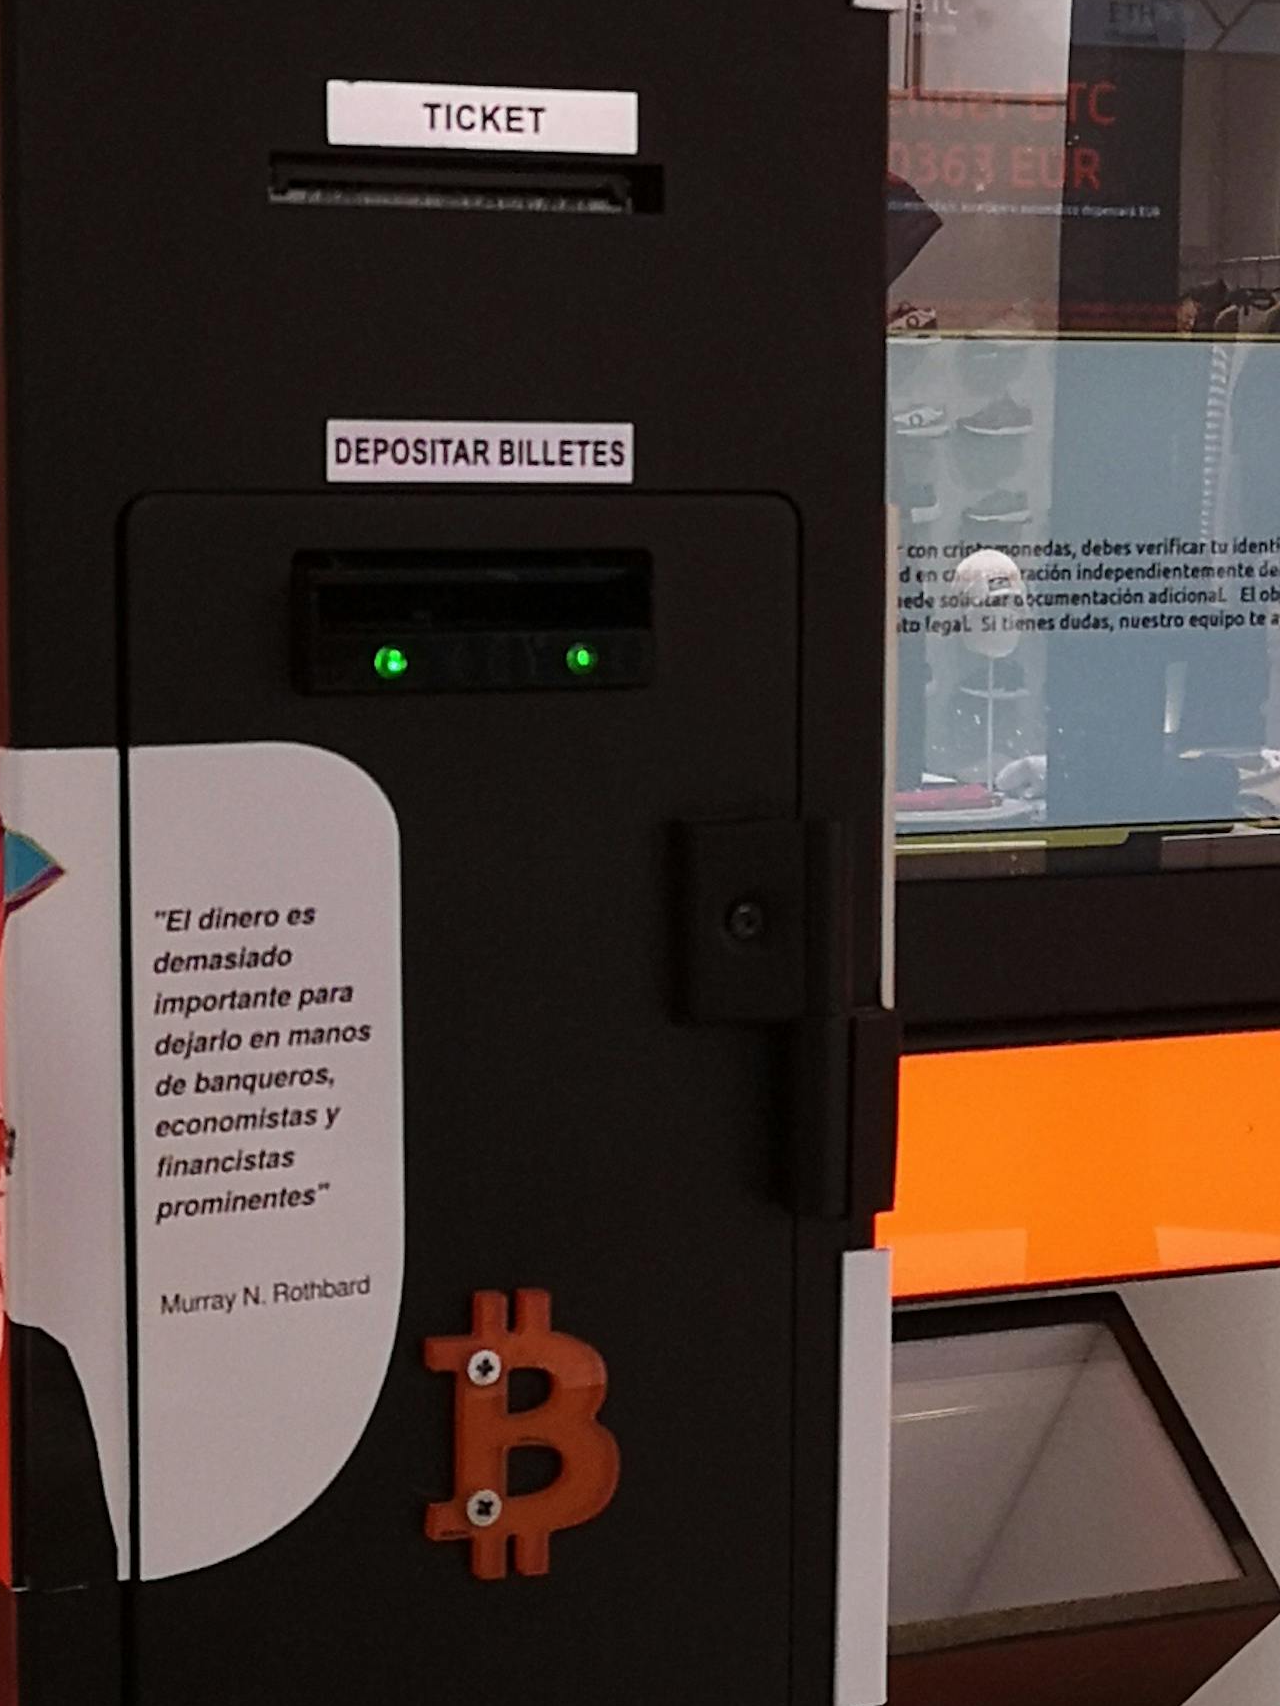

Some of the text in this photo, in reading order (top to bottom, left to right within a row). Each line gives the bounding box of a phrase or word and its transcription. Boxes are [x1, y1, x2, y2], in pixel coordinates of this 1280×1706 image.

[423, 102, 547, 134] TICKET
[1030, 79, 1119, 127] BTC
[1011, 145, 1101, 191] EUR
[335, 437, 626, 467] DEPOSITAR BILLETES
[907, 544, 938, 558] con
[943, 540, 1076, 560] criptmonedas,
[1081, 539, 1131, 556] debes
[1136, 538, 1206, 555] verificar
[1211, 540, 1227, 554] tu
[1076, 563, 1255, 583] independientemente
[1014, 587, 1144, 608] documentación
[1240, 586, 1256, 602] El
[981, 614, 996, 631] Si
[1002, 613, 1054, 631] tienes
[1060, 612, 1114, 632] dudas,
[1119, 612, 1184, 629] nuestro
[1189, 610, 1245, 630] equipo
[1249, 610, 1266, 624] te
[154, 906, 316, 932] "El dinero es
[153, 945, 293, 975] demasiado
[154, 985, 354, 1018] importante para
[154, 1023, 371, 1060] dejarlo en manos
[155, 1066, 335, 1097] de banqueros,
[155, 1106, 341, 1138] economistas y
[156, 1149, 296, 1179] financistas
[155, 1182, 331, 1225] prominentes"
[160, 1275, 371, 1315] Murray N. Rothbard
